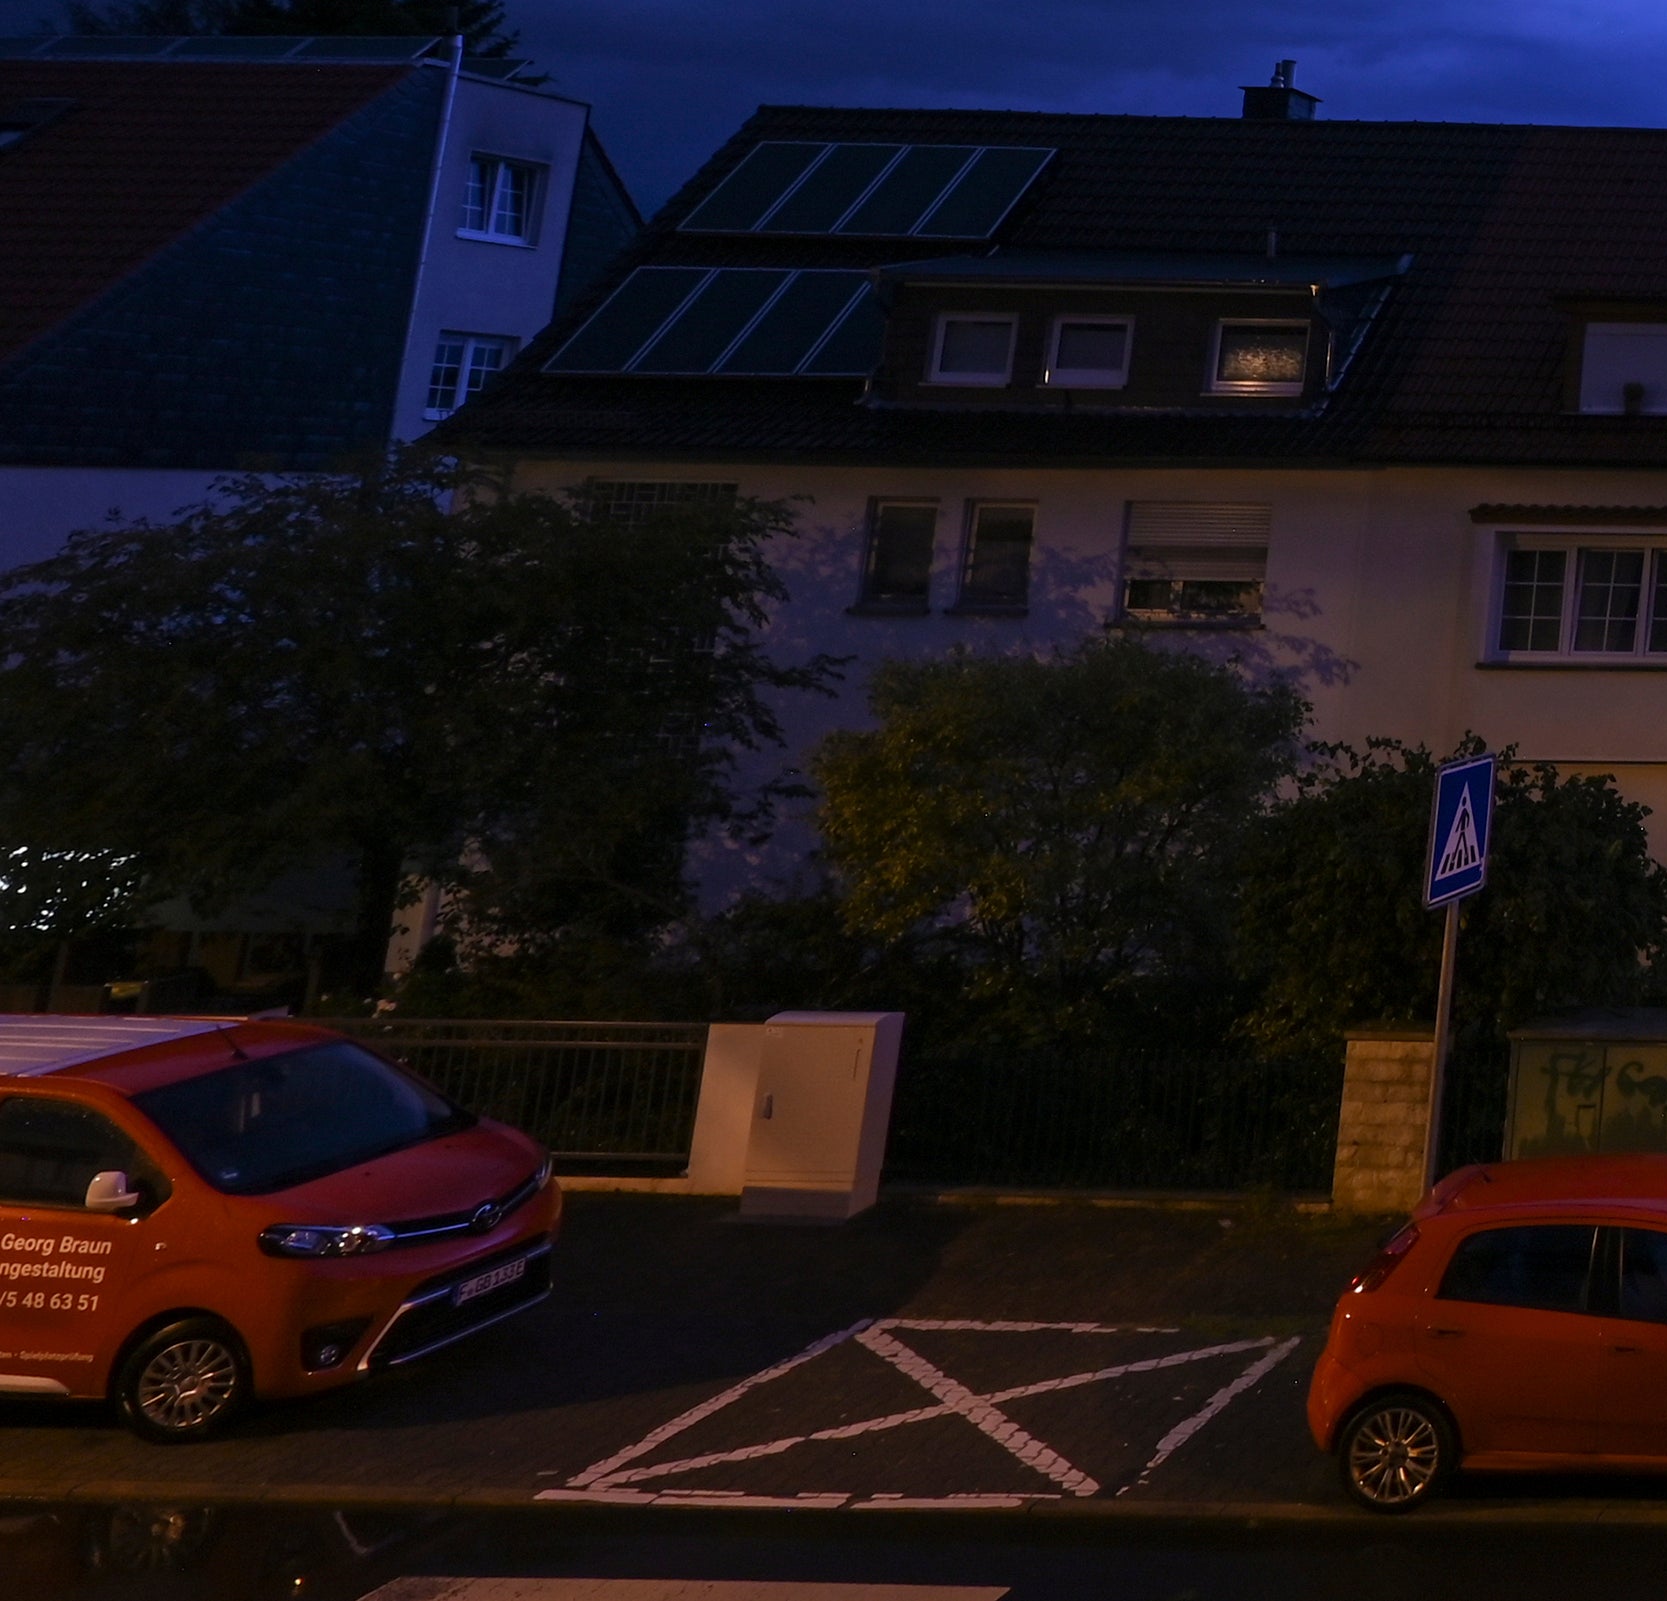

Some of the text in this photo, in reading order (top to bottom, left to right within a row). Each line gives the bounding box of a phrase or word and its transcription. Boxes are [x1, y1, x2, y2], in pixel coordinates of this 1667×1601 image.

[1, 1233, 112, 1256] Georg Braun
[0, 1260, 106, 1284] ngestaltung
[21, 1291, 46, 1309] 48
[49, 1292, 74, 1310] 63
[77, 1294, 99, 1311] 51
